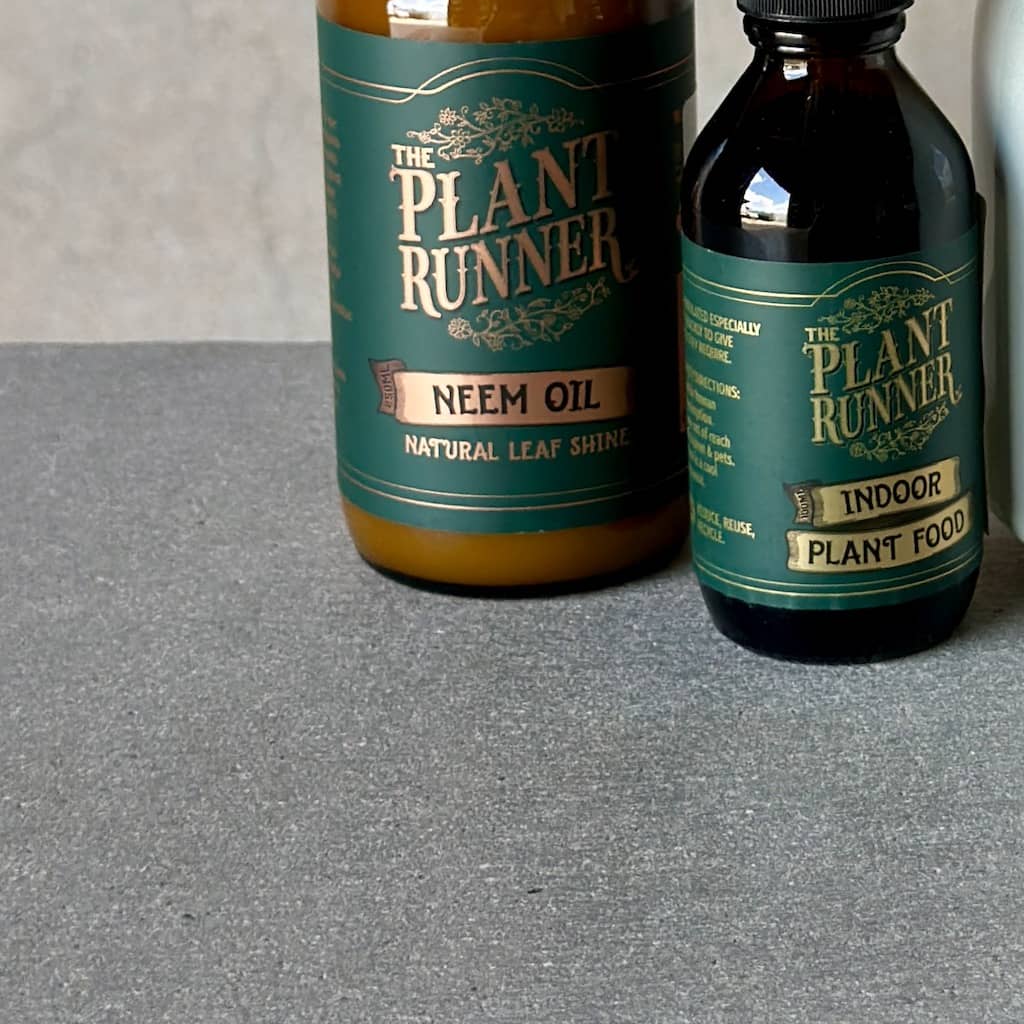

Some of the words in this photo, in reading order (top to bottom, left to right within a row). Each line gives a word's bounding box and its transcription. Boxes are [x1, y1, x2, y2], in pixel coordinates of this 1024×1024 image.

[391, 143, 436, 170] THE
[390, 128, 620, 244] PLANT
[398, 207, 640, 320] RUNNER
[709, 312, 762, 337] ESPECIALLY
[714, 331, 734, 349] GIVE
[804, 326, 841, 344] THE
[801, 297, 955, 396] PLANT
[433, 382, 529, 416] NEEM
[543, 380, 602, 412] OIL
[810, 351, 964, 446] RUNNER
[403, 432, 500, 464] NATURAL
[508, 435, 563, 463] LEAF
[569, 425, 631, 458] SHINE
[709, 432, 731, 449] reach
[713, 451, 736, 467] pets.
[841, 470, 943, 516] INDOOR
[722, 516, 756, 540] REUSE,
[808, 533, 903, 567] PLANT
[912, 509, 966, 554] FOOD
